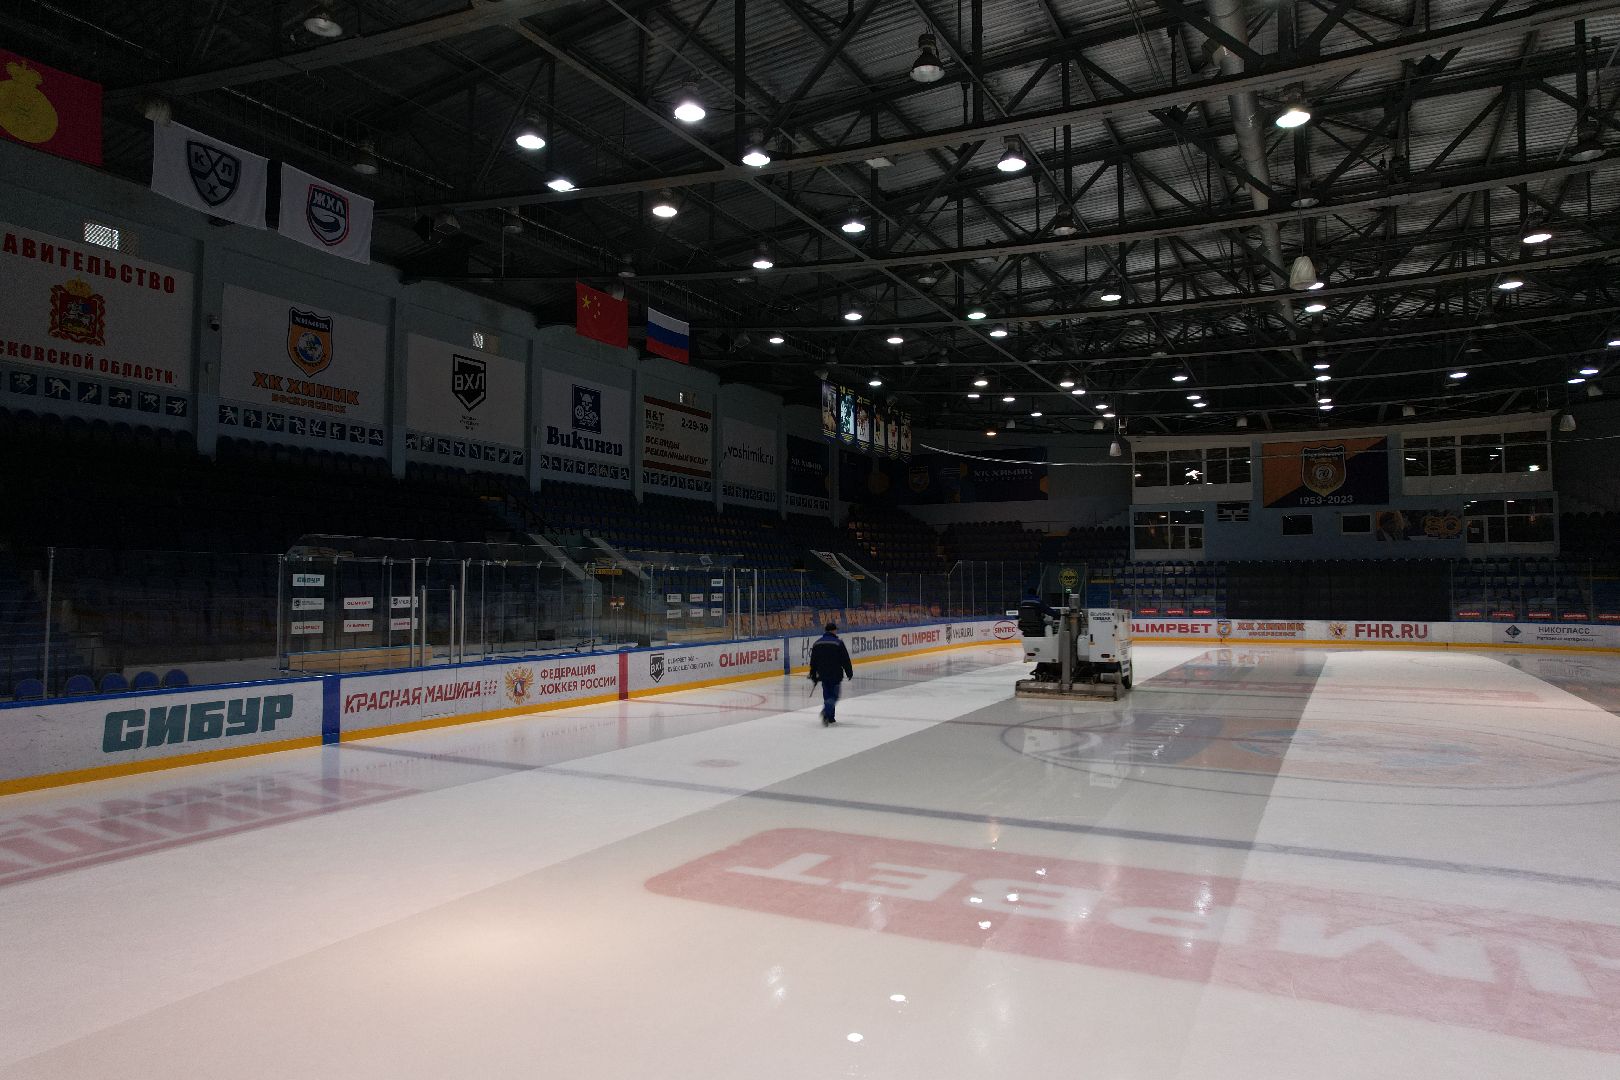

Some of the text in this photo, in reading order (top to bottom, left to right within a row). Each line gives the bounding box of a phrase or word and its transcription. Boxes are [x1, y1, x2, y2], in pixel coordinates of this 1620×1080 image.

[312, 188, 345, 218] ЖХЛ
[99, 358, 174, 384] ОБЛАСТИ
[252, 371, 360, 406] ХК ХИМИК
[454, 373, 485, 391] ВХЛ
[1299, 494, 1354, 505] 1953-2023
[994, 626, 1016, 634] SINTEC
[1236, 622, 1306, 632] ХК ХИМИК
[1354, 623, 1428, 639] FHR.RU
[1538, 626, 1591, 635] НИКОГЛАСС
[901, 629, 942, 646] OLIMPBET
[719, 647, 780, 667] OLIMPBET
[539, 664, 597, 681] ФЕДЕРАЦИЯ
[539, 675, 617, 696] ХОККЕЯ РОССИИ
[344, 680, 482, 714] КРАСНАЯ МАШИНА
[102, 694, 293, 754] СИБУР
[721, 853, 1620, 997] IMPBET
